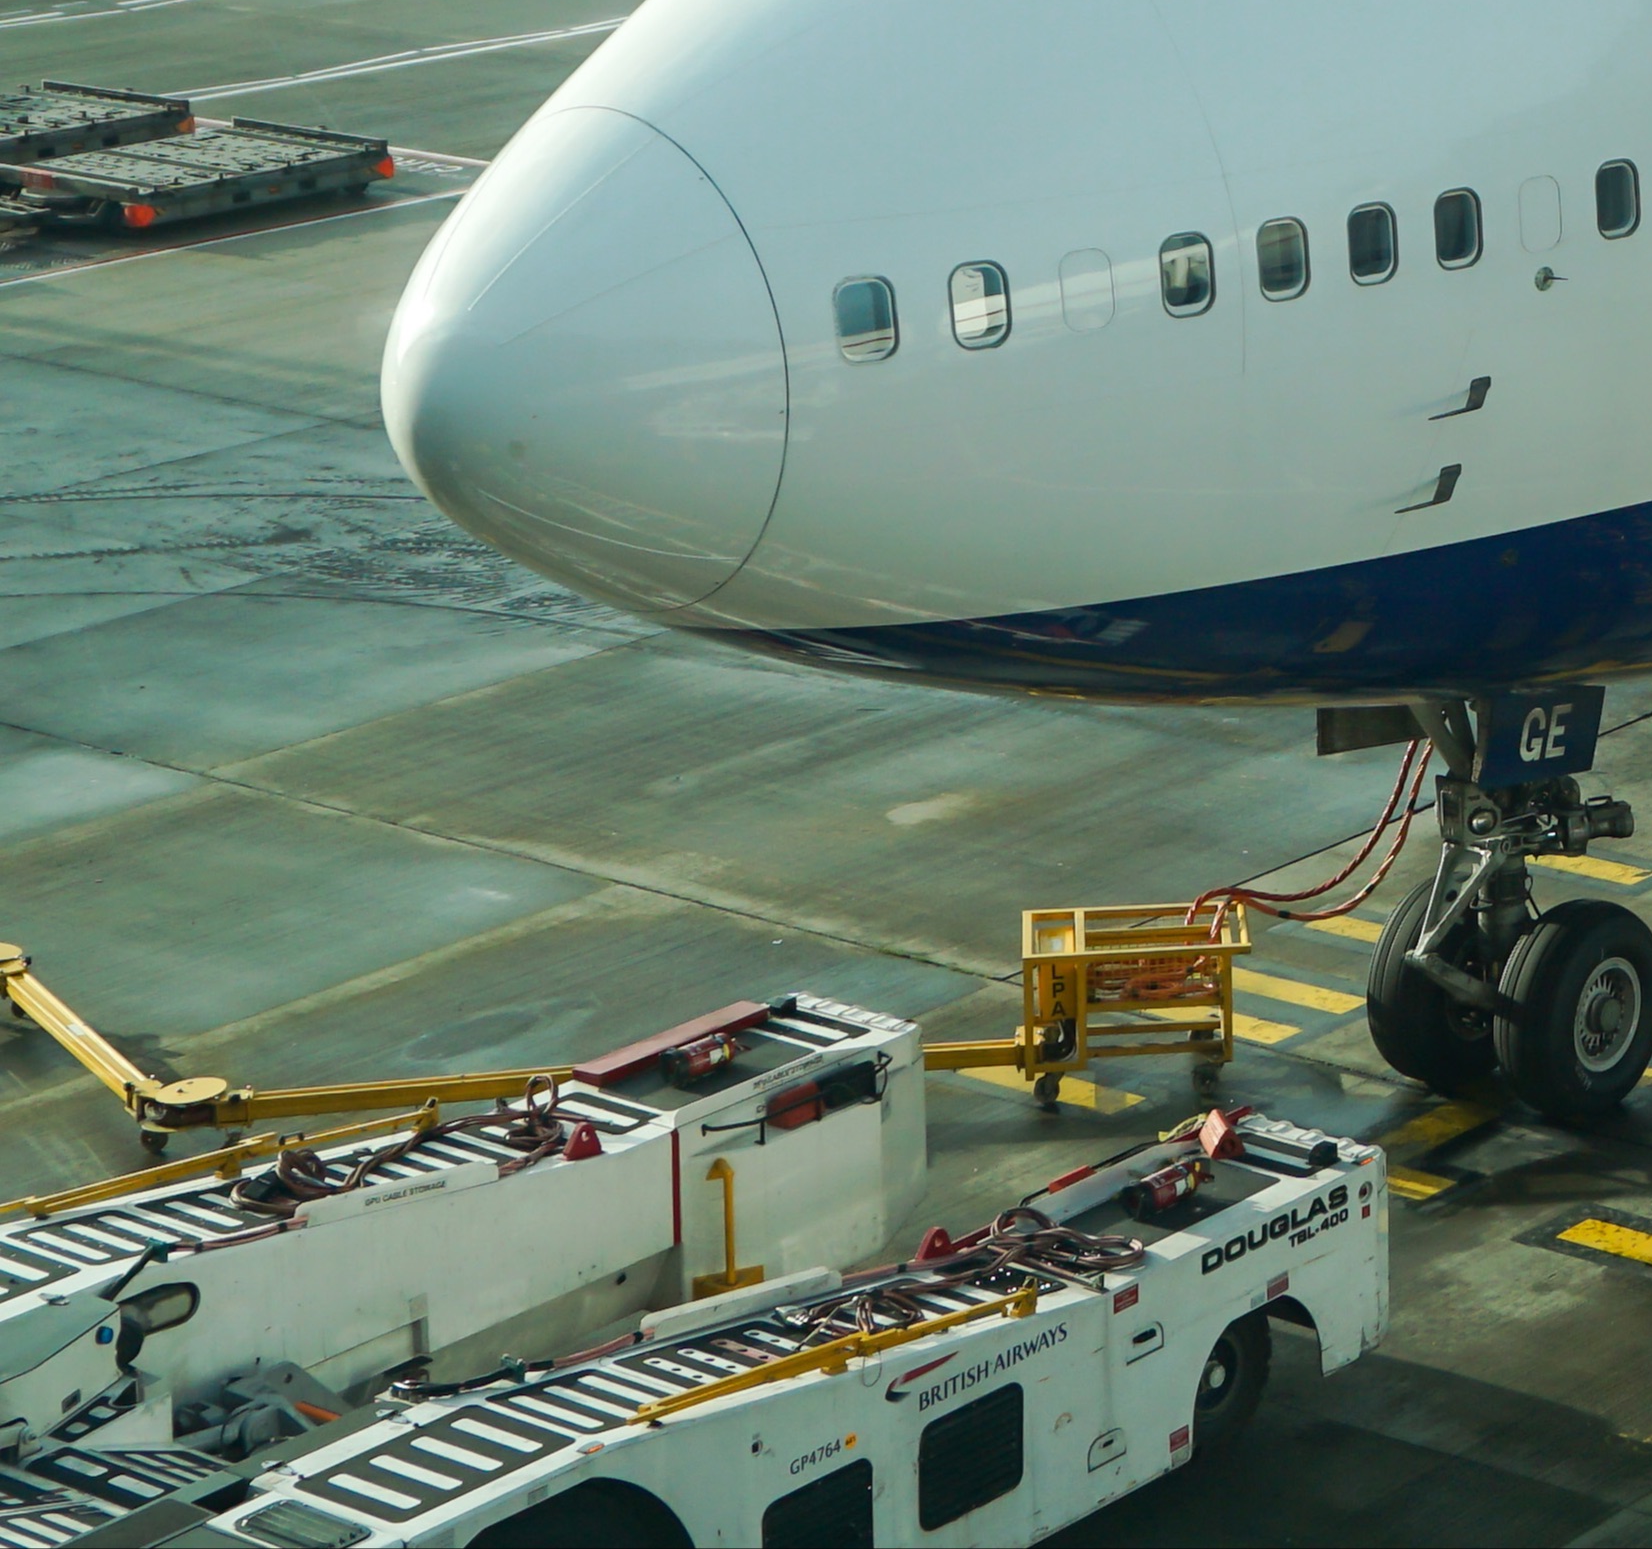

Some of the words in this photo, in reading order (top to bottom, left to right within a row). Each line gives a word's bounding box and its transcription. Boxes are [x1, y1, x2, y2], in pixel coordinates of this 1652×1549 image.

[1519, 703, 1573, 762] GE
[365, 1195, 381, 1207] GPU
[382, 1190, 408, 1203] CABLE
[409, 1180, 446, 1196] STORAGE
[1201, 1184, 1349, 1276] DOUGLAS
[919, 1360, 989, 1412] BRITISH
[993, 1322, 1068, 1375] AIRWAYS
[790, 1438, 841, 1475] GP4764
